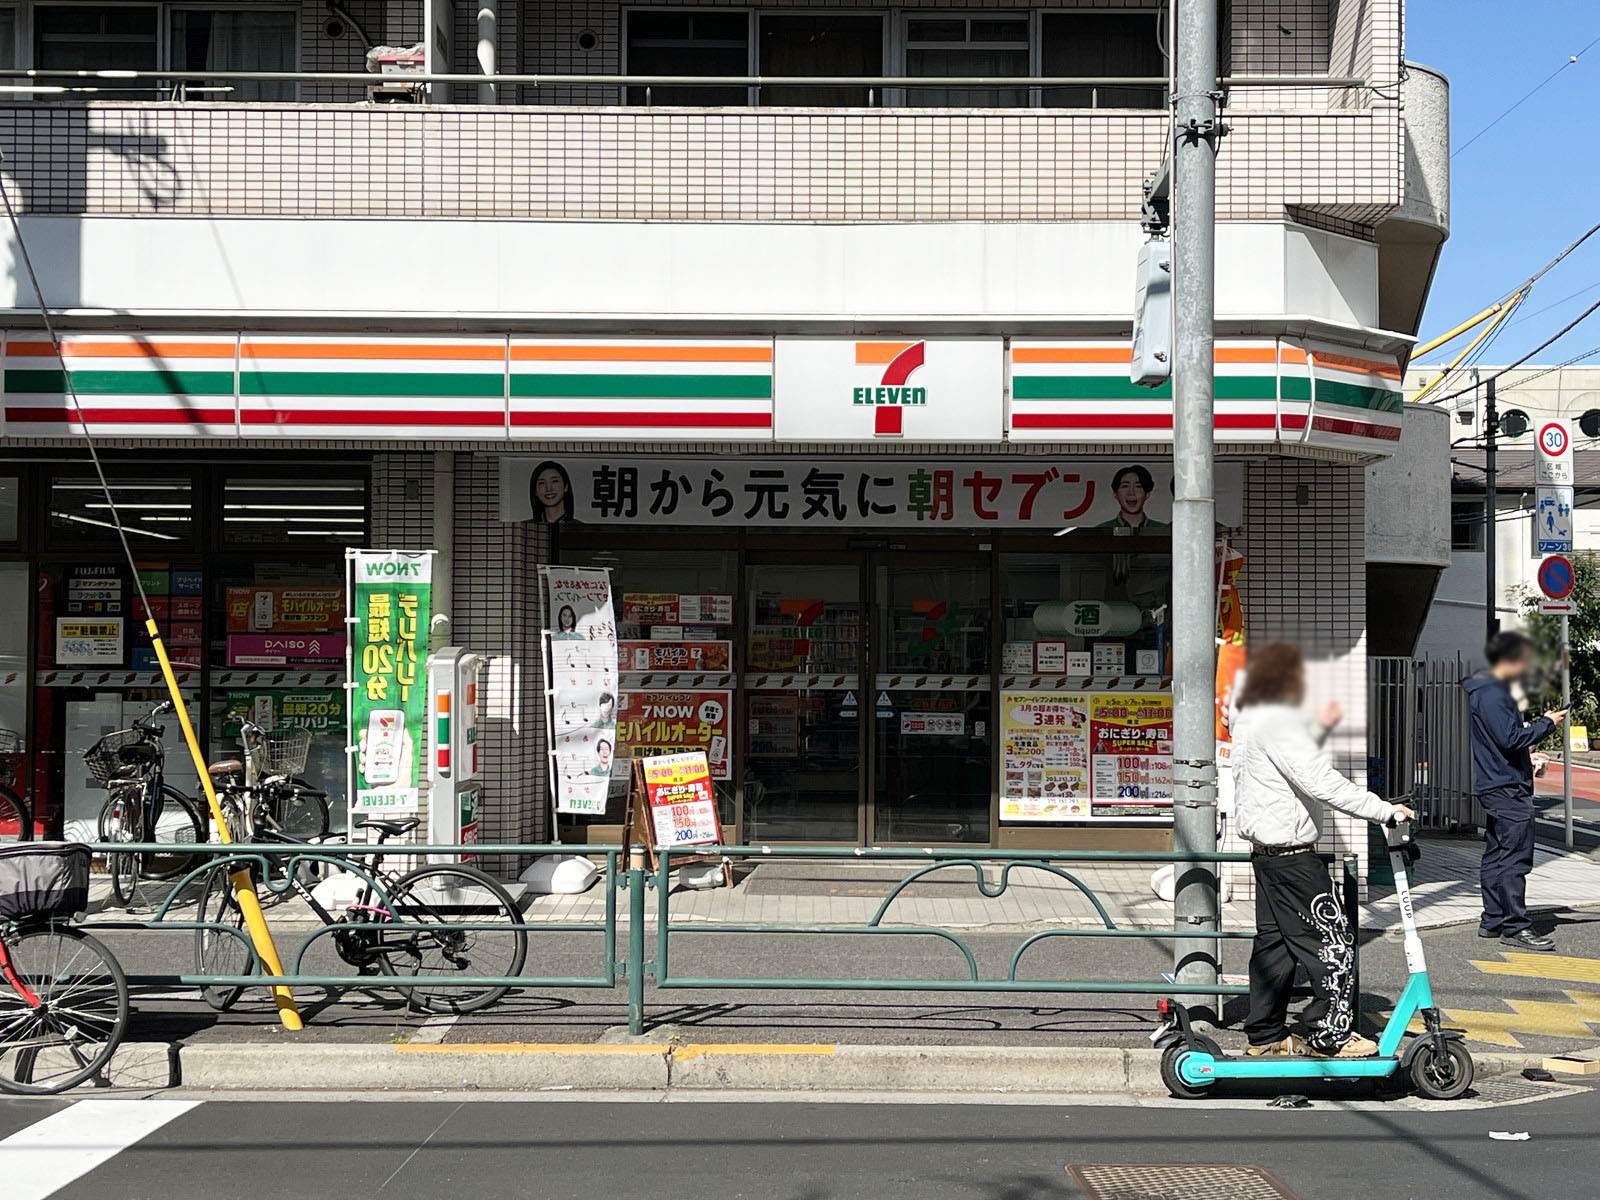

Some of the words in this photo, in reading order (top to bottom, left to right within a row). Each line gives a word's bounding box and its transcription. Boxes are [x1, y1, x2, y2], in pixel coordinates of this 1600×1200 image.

[1545, 432, 1563, 448] 30
[1541, 471, 1569, 481] ここから
[591, 466, 1096, 523] 朝から元気に朝セブン
[1539, 542, 1572, 552] ゾーン30
[1074, 604, 1100, 625] 酒
[80, 625, 117, 636] 駐輪禁止
[1075, 627, 1100, 637] liquor
[264, 640, 306, 649] DAISO
[654, 648, 687, 657] モバイル
[655, 657, 688, 666] オーダー
[282, 703, 342, 716] 最短20分
[641, 705, 694, 719] 7NOW
[281, 716, 341, 729] デリバリー
[1033, 712, 1066, 726] 3連発
[615, 720, 723, 743] モバイルオーダー
[1098, 728, 1168, 740] おにぎり・寿司
[1112, 740, 1135, 748] SUPER
[1136, 740, 1154, 748] SALE
[1401, 890, 1413, 919] LUUP
